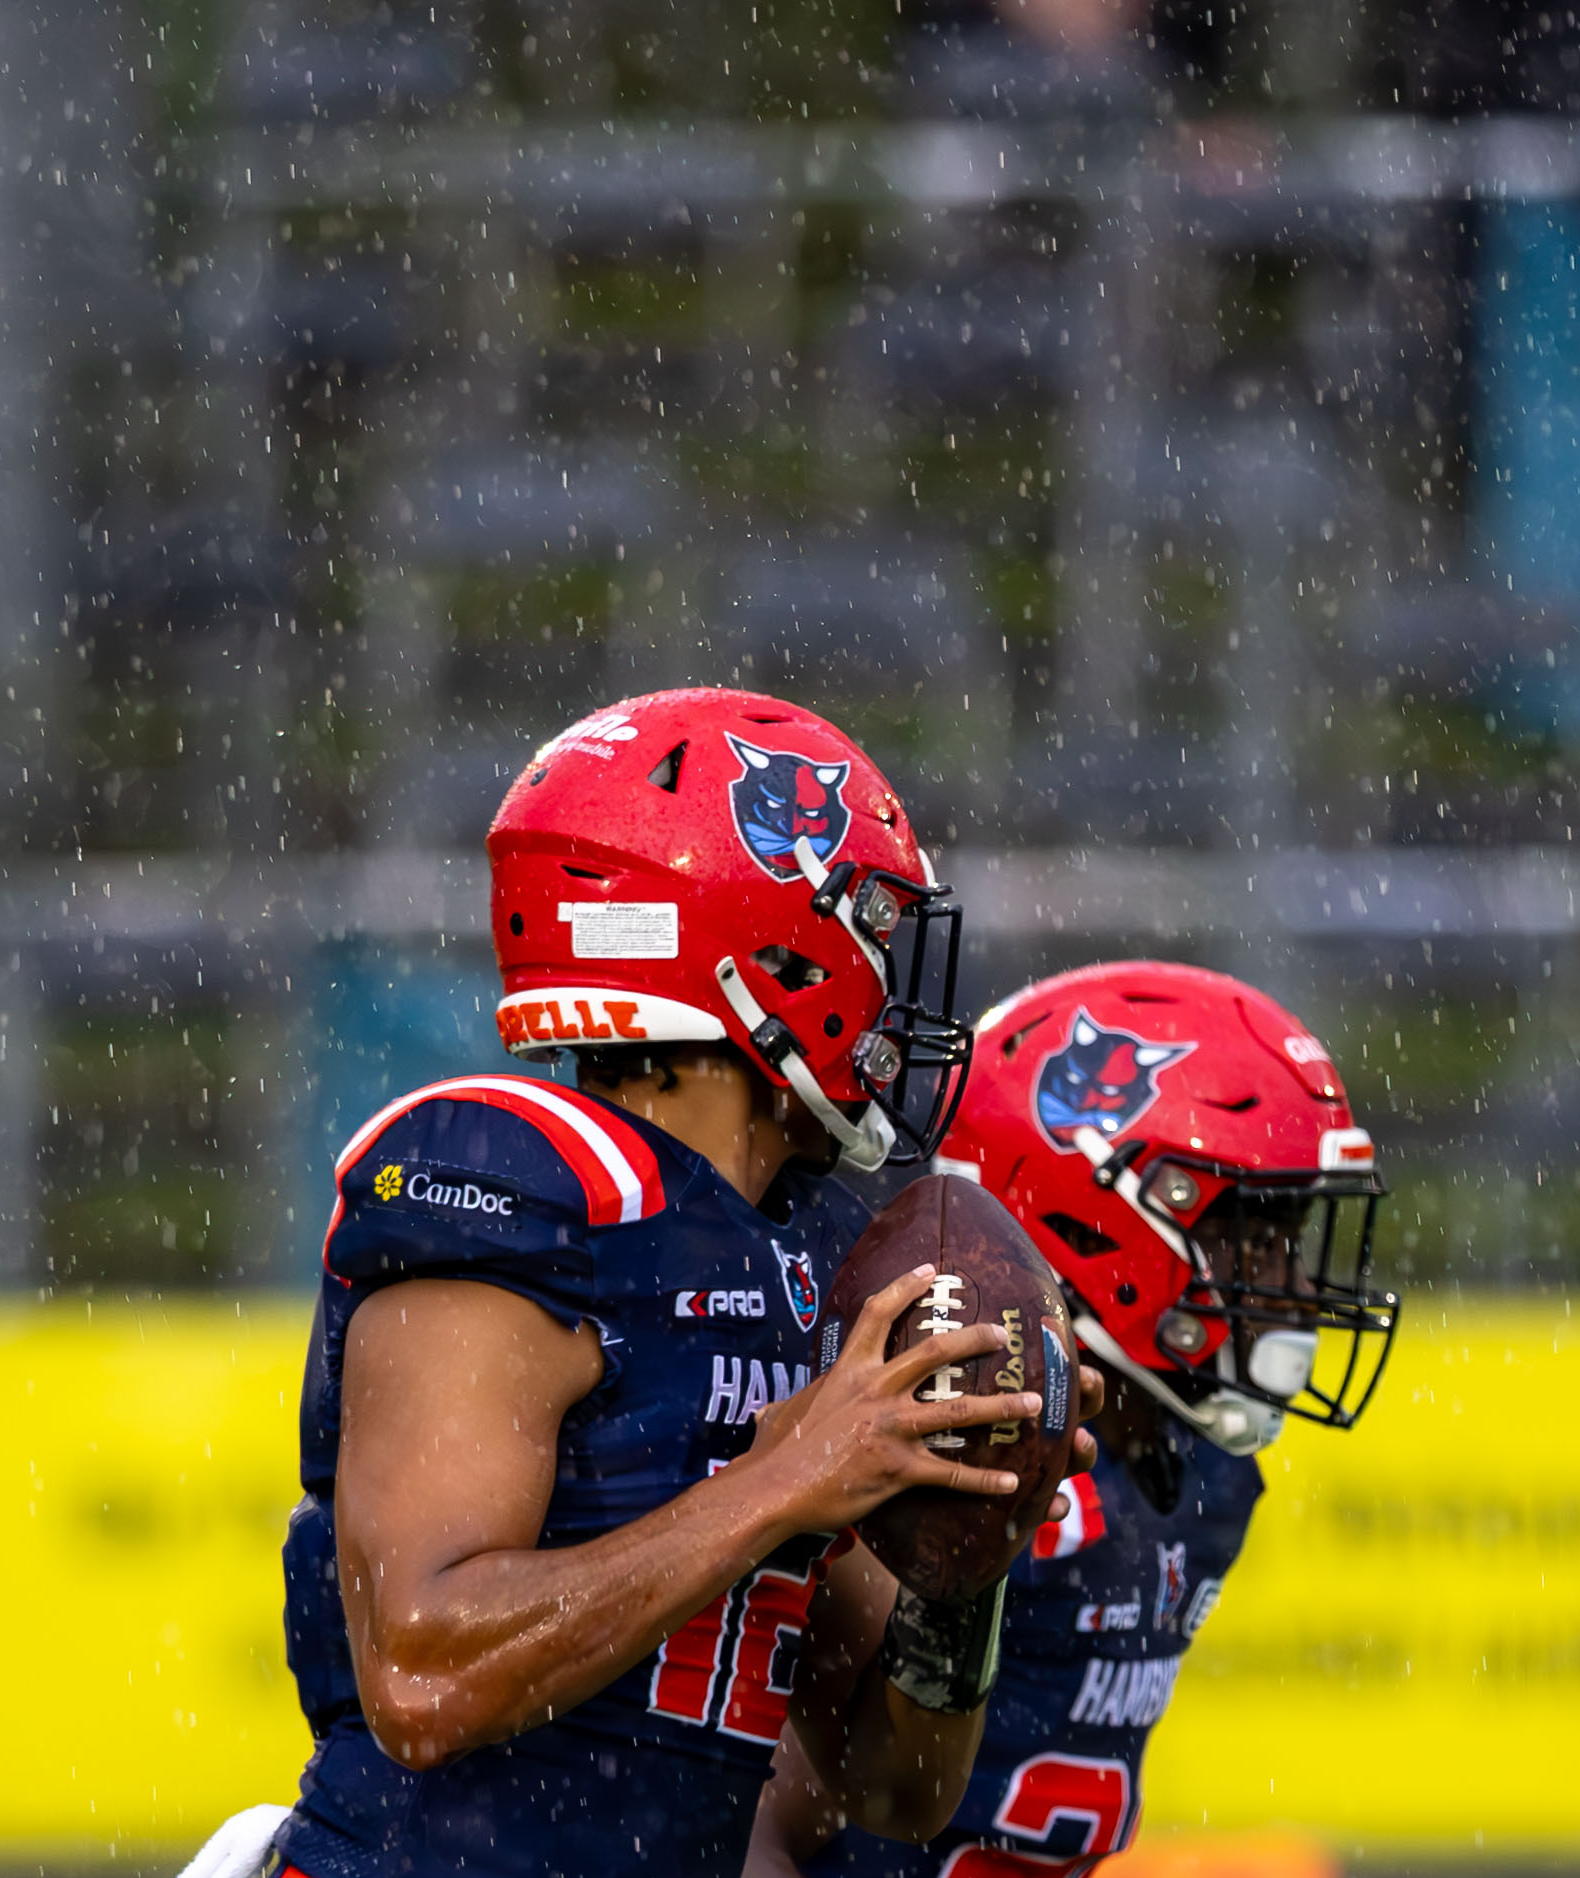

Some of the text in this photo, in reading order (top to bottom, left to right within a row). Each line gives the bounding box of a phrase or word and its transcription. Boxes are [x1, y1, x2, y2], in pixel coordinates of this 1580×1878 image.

[407, 1173, 513, 1216] CanDoc
[705, 1354, 811, 1425] HAM
[988, 1307, 1026, 1447] Wlson
